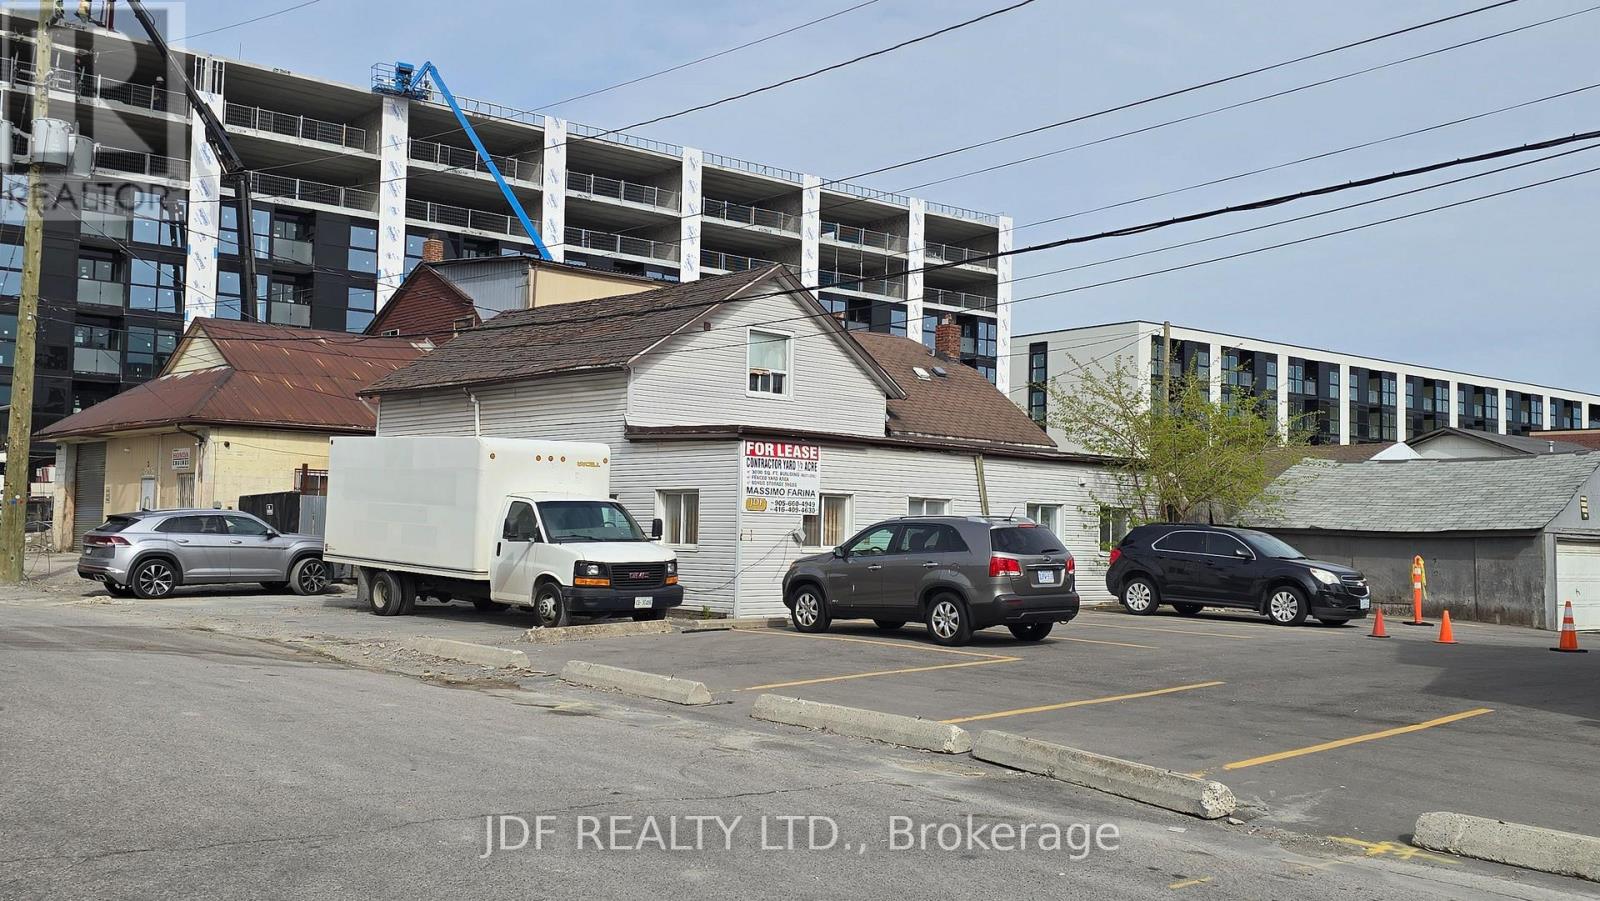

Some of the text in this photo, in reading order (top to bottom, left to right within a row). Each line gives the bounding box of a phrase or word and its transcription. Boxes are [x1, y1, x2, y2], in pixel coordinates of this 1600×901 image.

[746, 441, 818, 459] FOR LEASE
[746, 457, 782, 469] CONTRACTOR
[783, 459, 797, 471] YARD
[804, 461, 818, 473] ACRE
[746, 486, 816, 498] MASSIMO FARINA
